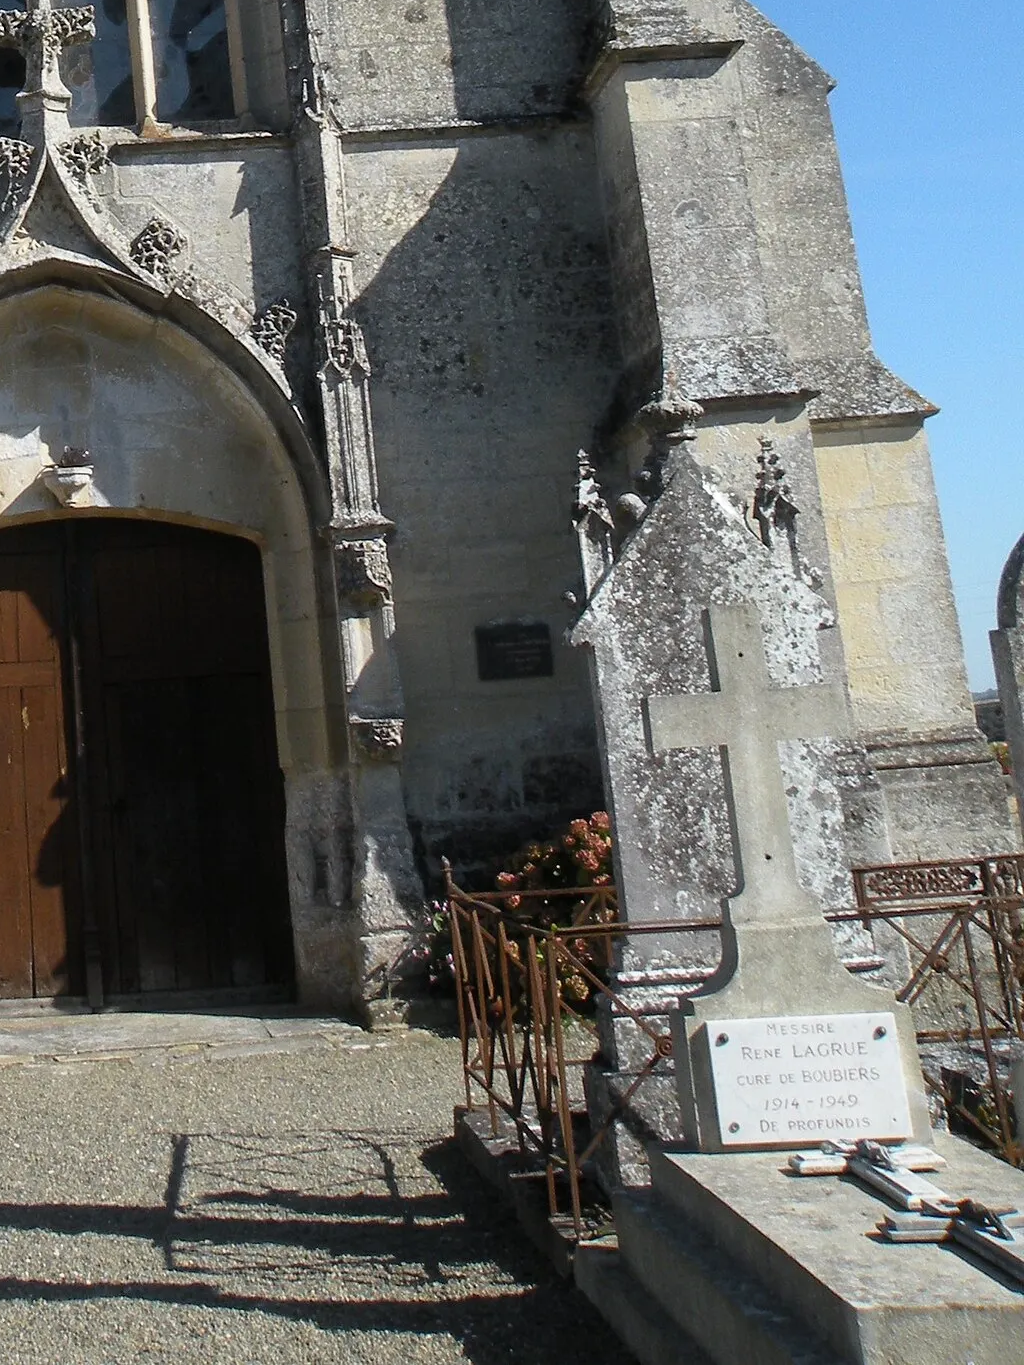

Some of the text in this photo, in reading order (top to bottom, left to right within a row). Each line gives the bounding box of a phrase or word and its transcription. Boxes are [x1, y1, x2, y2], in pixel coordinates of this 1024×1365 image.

[766, 1022, 836, 1036] MESSIRE
[792, 1041, 868, 1059] LAGRUE
[736, 1067, 881, 1086] CURE DE BOUBIERS
[764, 1097, 800, 1111] 1914
[819, 1094, 858, 1109] 1949
[760, 1117, 871, 1133] DE PROFUNDIS
